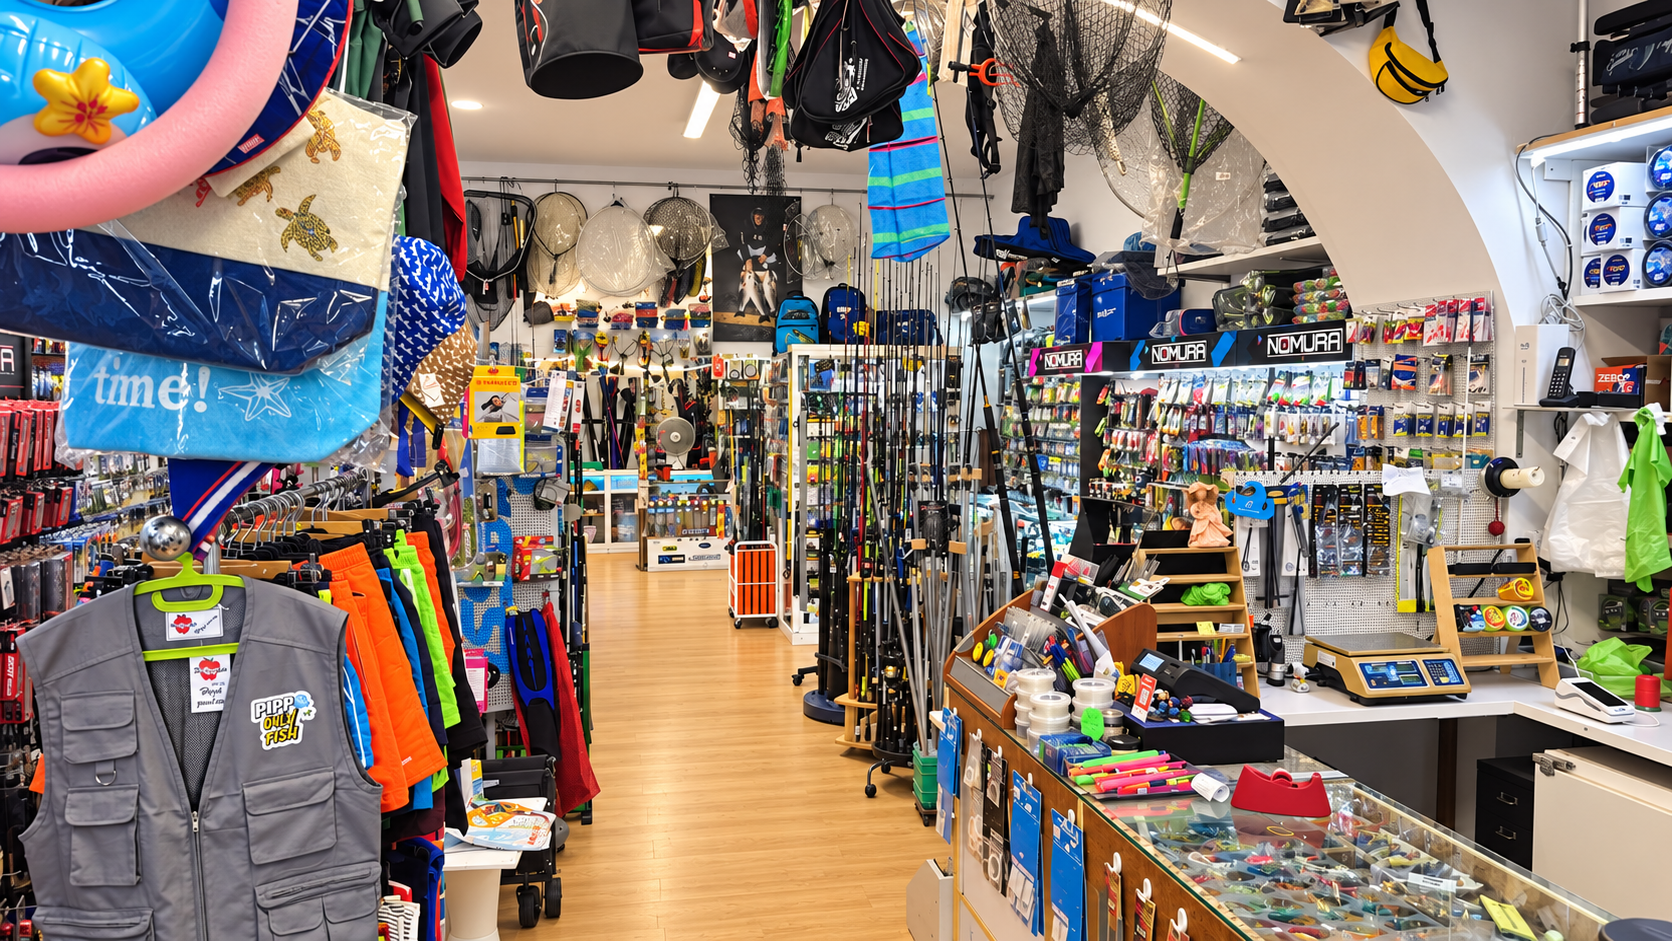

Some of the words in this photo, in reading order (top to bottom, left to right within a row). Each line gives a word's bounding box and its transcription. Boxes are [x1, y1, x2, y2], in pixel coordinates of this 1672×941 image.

[1152, 343, 1206, 362] NOMURA
[1266, 331, 1341, 355] NOMURA
[1045, 352, 1082, 368] NOMURA
[93, 356, 211, 413] time!
[263, 708, 299, 731] ONLY
[265, 725, 299, 746] FISH
